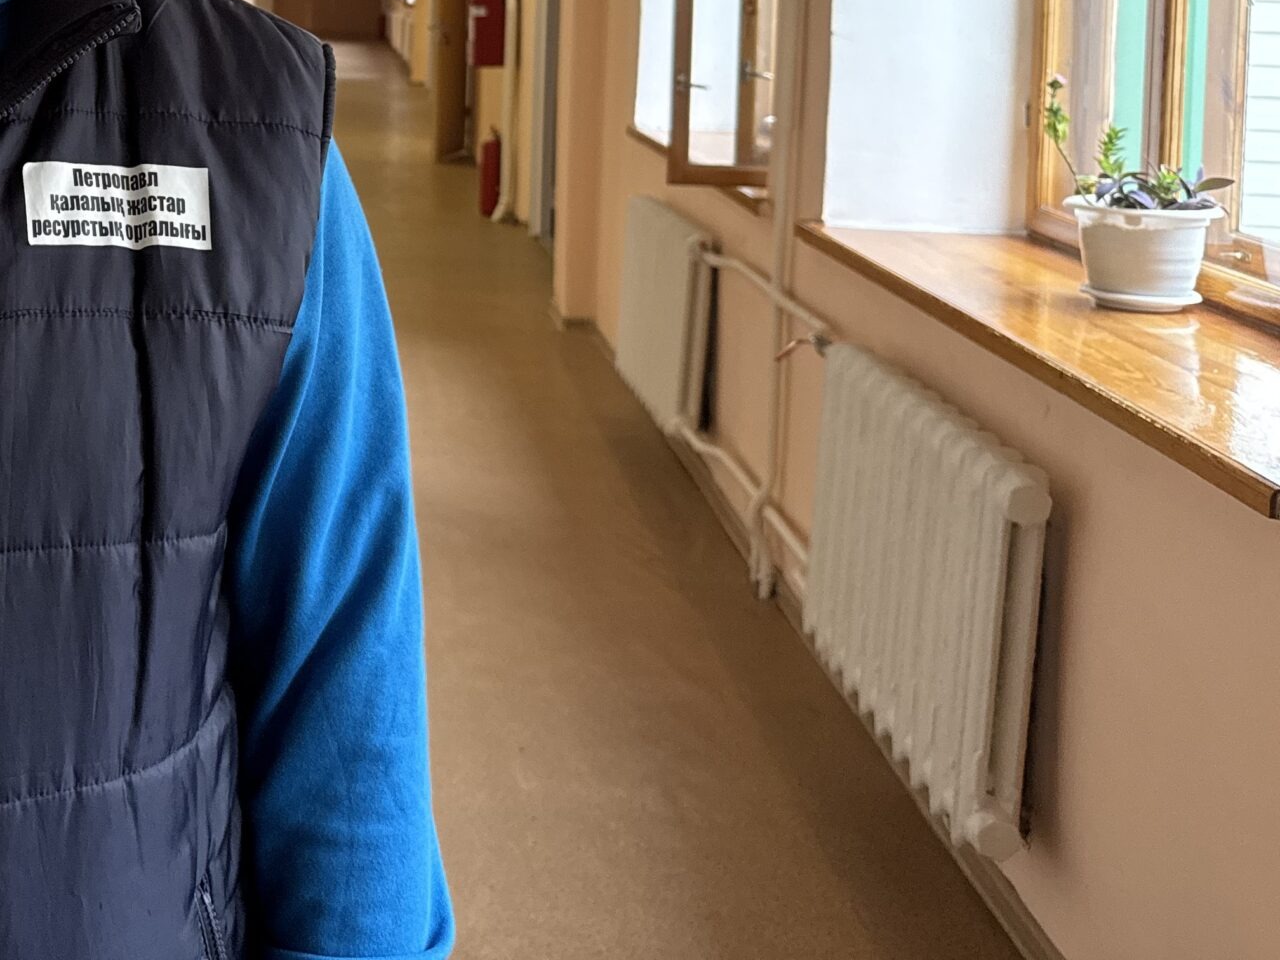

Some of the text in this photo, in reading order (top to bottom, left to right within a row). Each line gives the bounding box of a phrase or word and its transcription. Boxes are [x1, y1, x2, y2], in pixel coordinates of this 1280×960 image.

[73, 168, 158, 191] Петропавл
[50, 194, 185, 217] қалалық жастар
[32, 219, 207, 243] ресурстық орталығы
